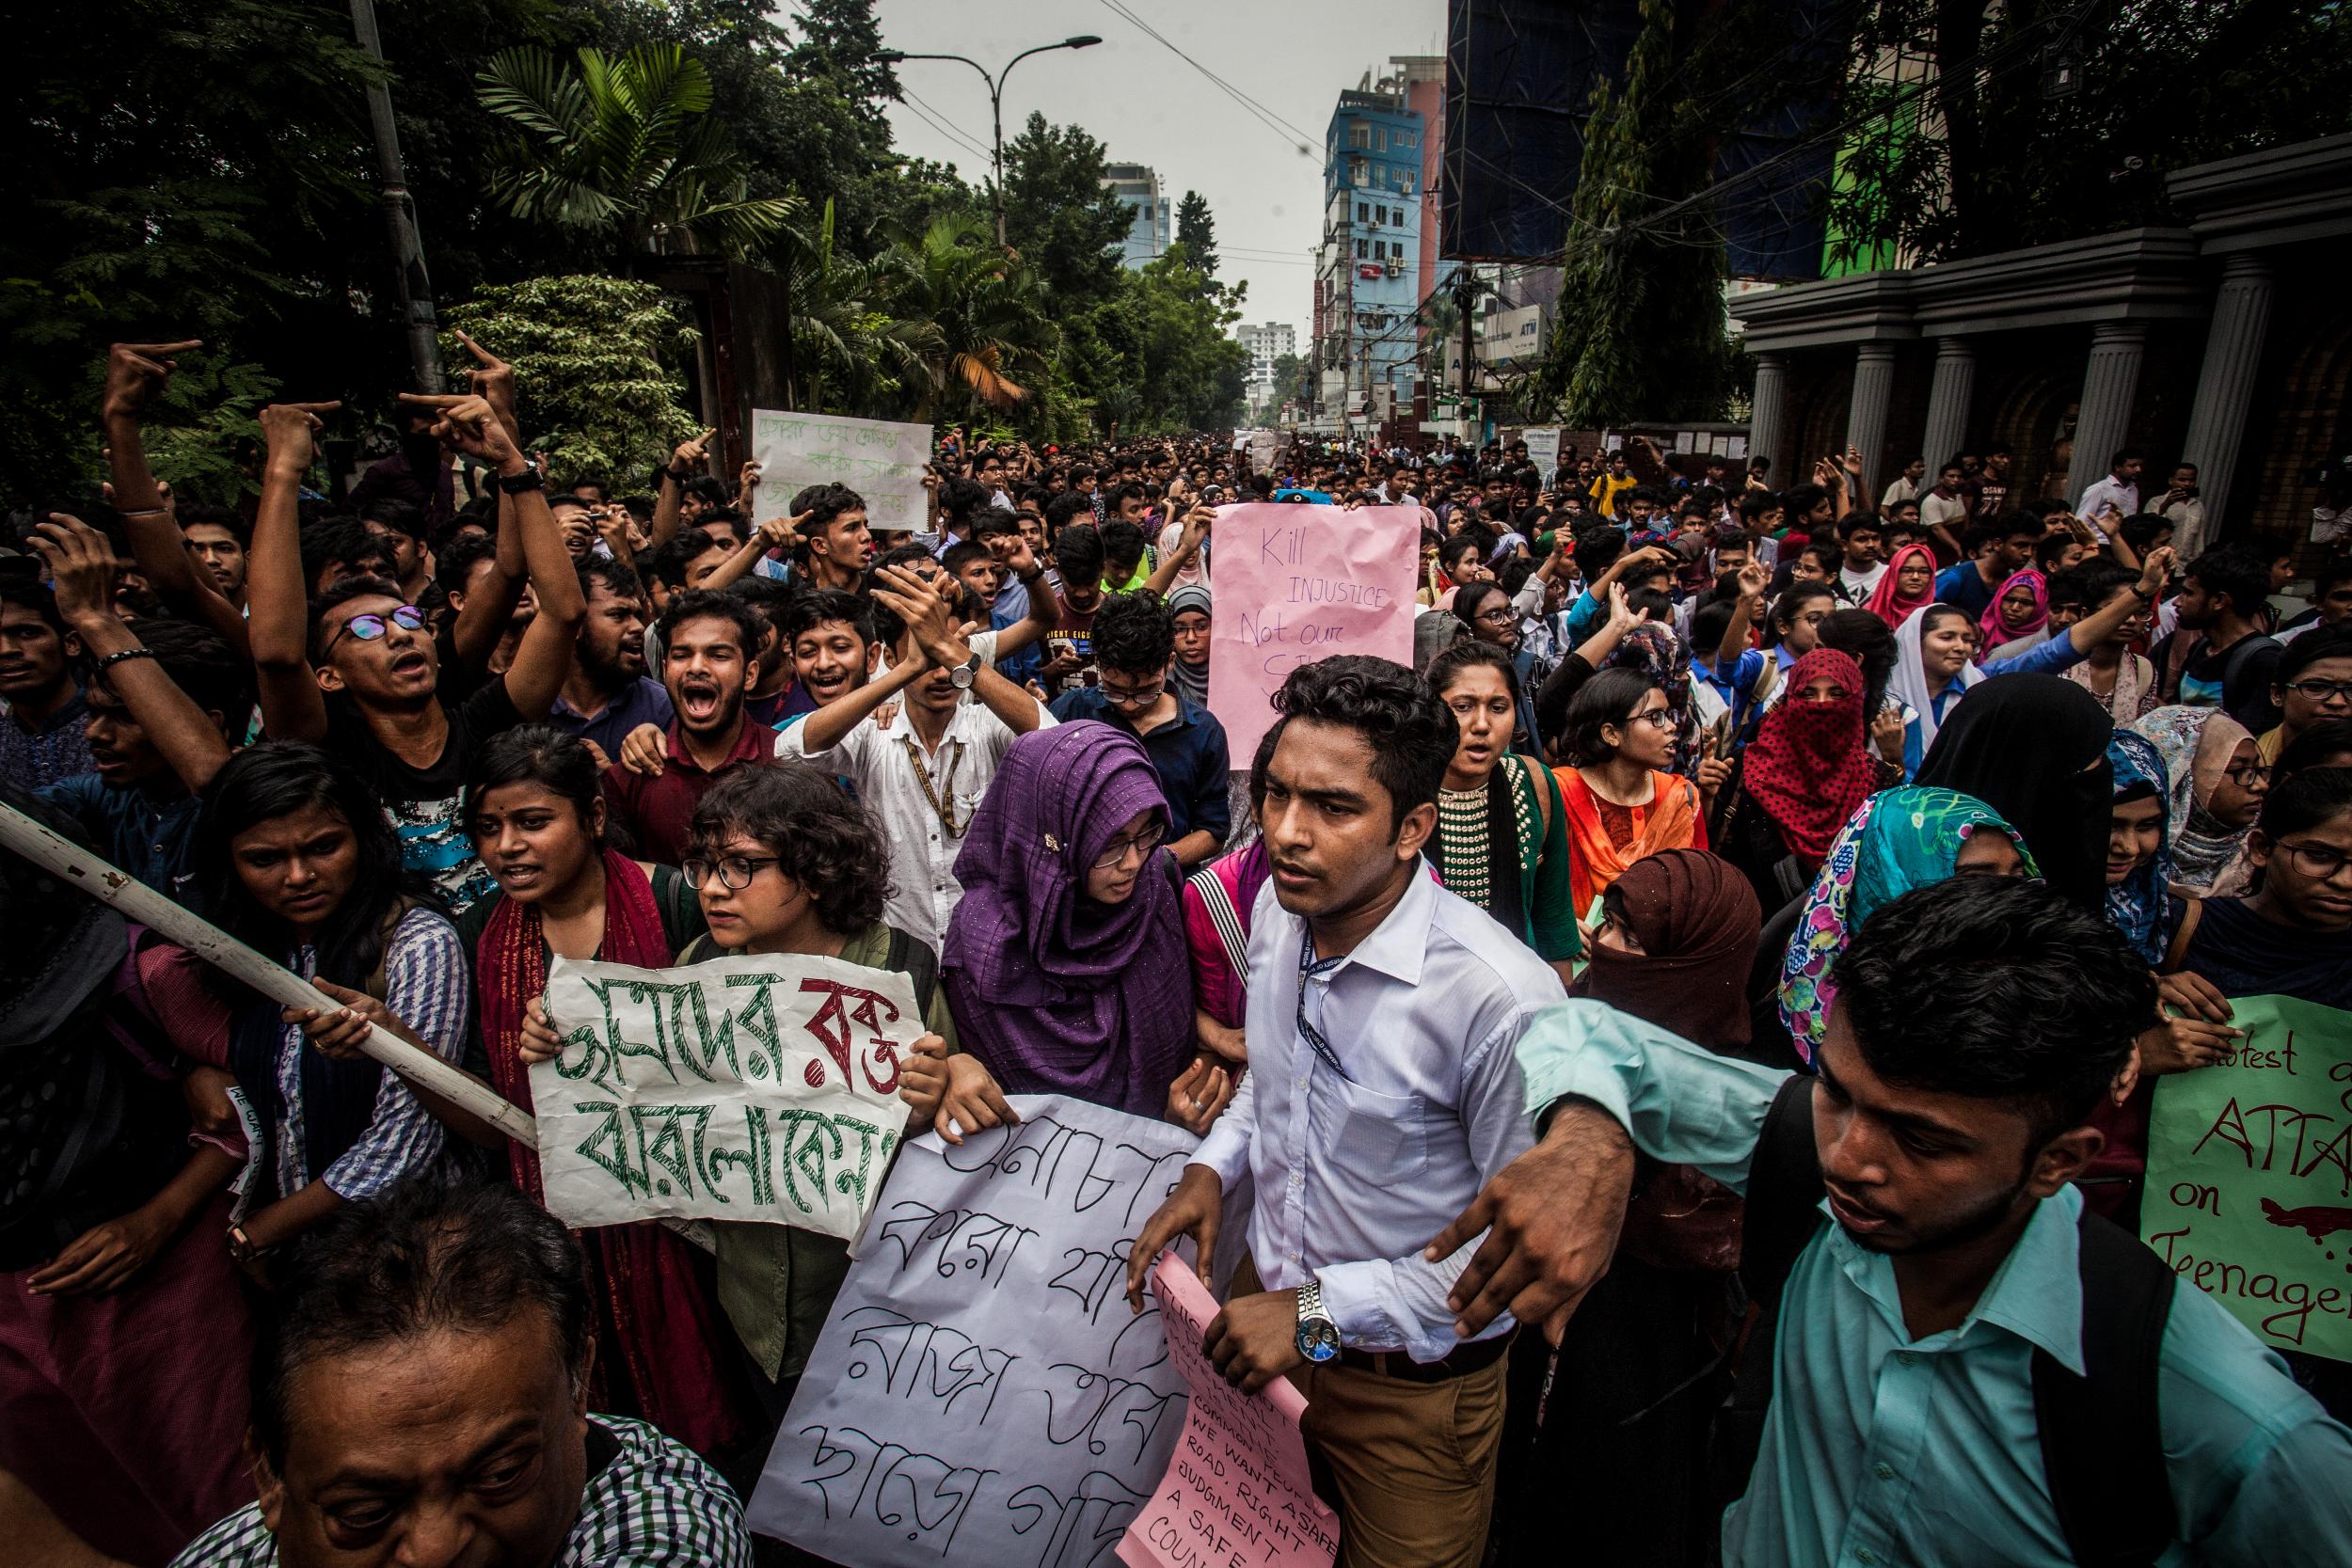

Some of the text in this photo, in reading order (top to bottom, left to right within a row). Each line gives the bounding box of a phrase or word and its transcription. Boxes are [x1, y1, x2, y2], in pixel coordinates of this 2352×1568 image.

[1520, 322, 1537, 337] ATM
[1452, 359, 1482, 370] AM
[1263, 527, 1307, 566] Kill
[1287, 577, 1387, 610] INJUSTICE
[1241, 610, 1343, 647] Not our
[1302, 947, 1311, 966] WORLD
[1309, 1029, 1325, 1049] WORLD
[2217, 1029, 2298, 1076] otest
[230, 1086, 246, 1106] WE
[246, 1110, 263, 1146] WANT
[2169, 1181, 2221, 1217] on
[1194, 1395, 1253, 1453] COMMON
[1192, 1413, 1217, 1442] WE
[1225, 1442, 1279, 1495] WANT
[1167, 1489, 1248, 1568] A SAFE
[1178, 1460, 1280, 1563] JUDGMENT
[1236, 1481, 1306, 1552] RIGHT
